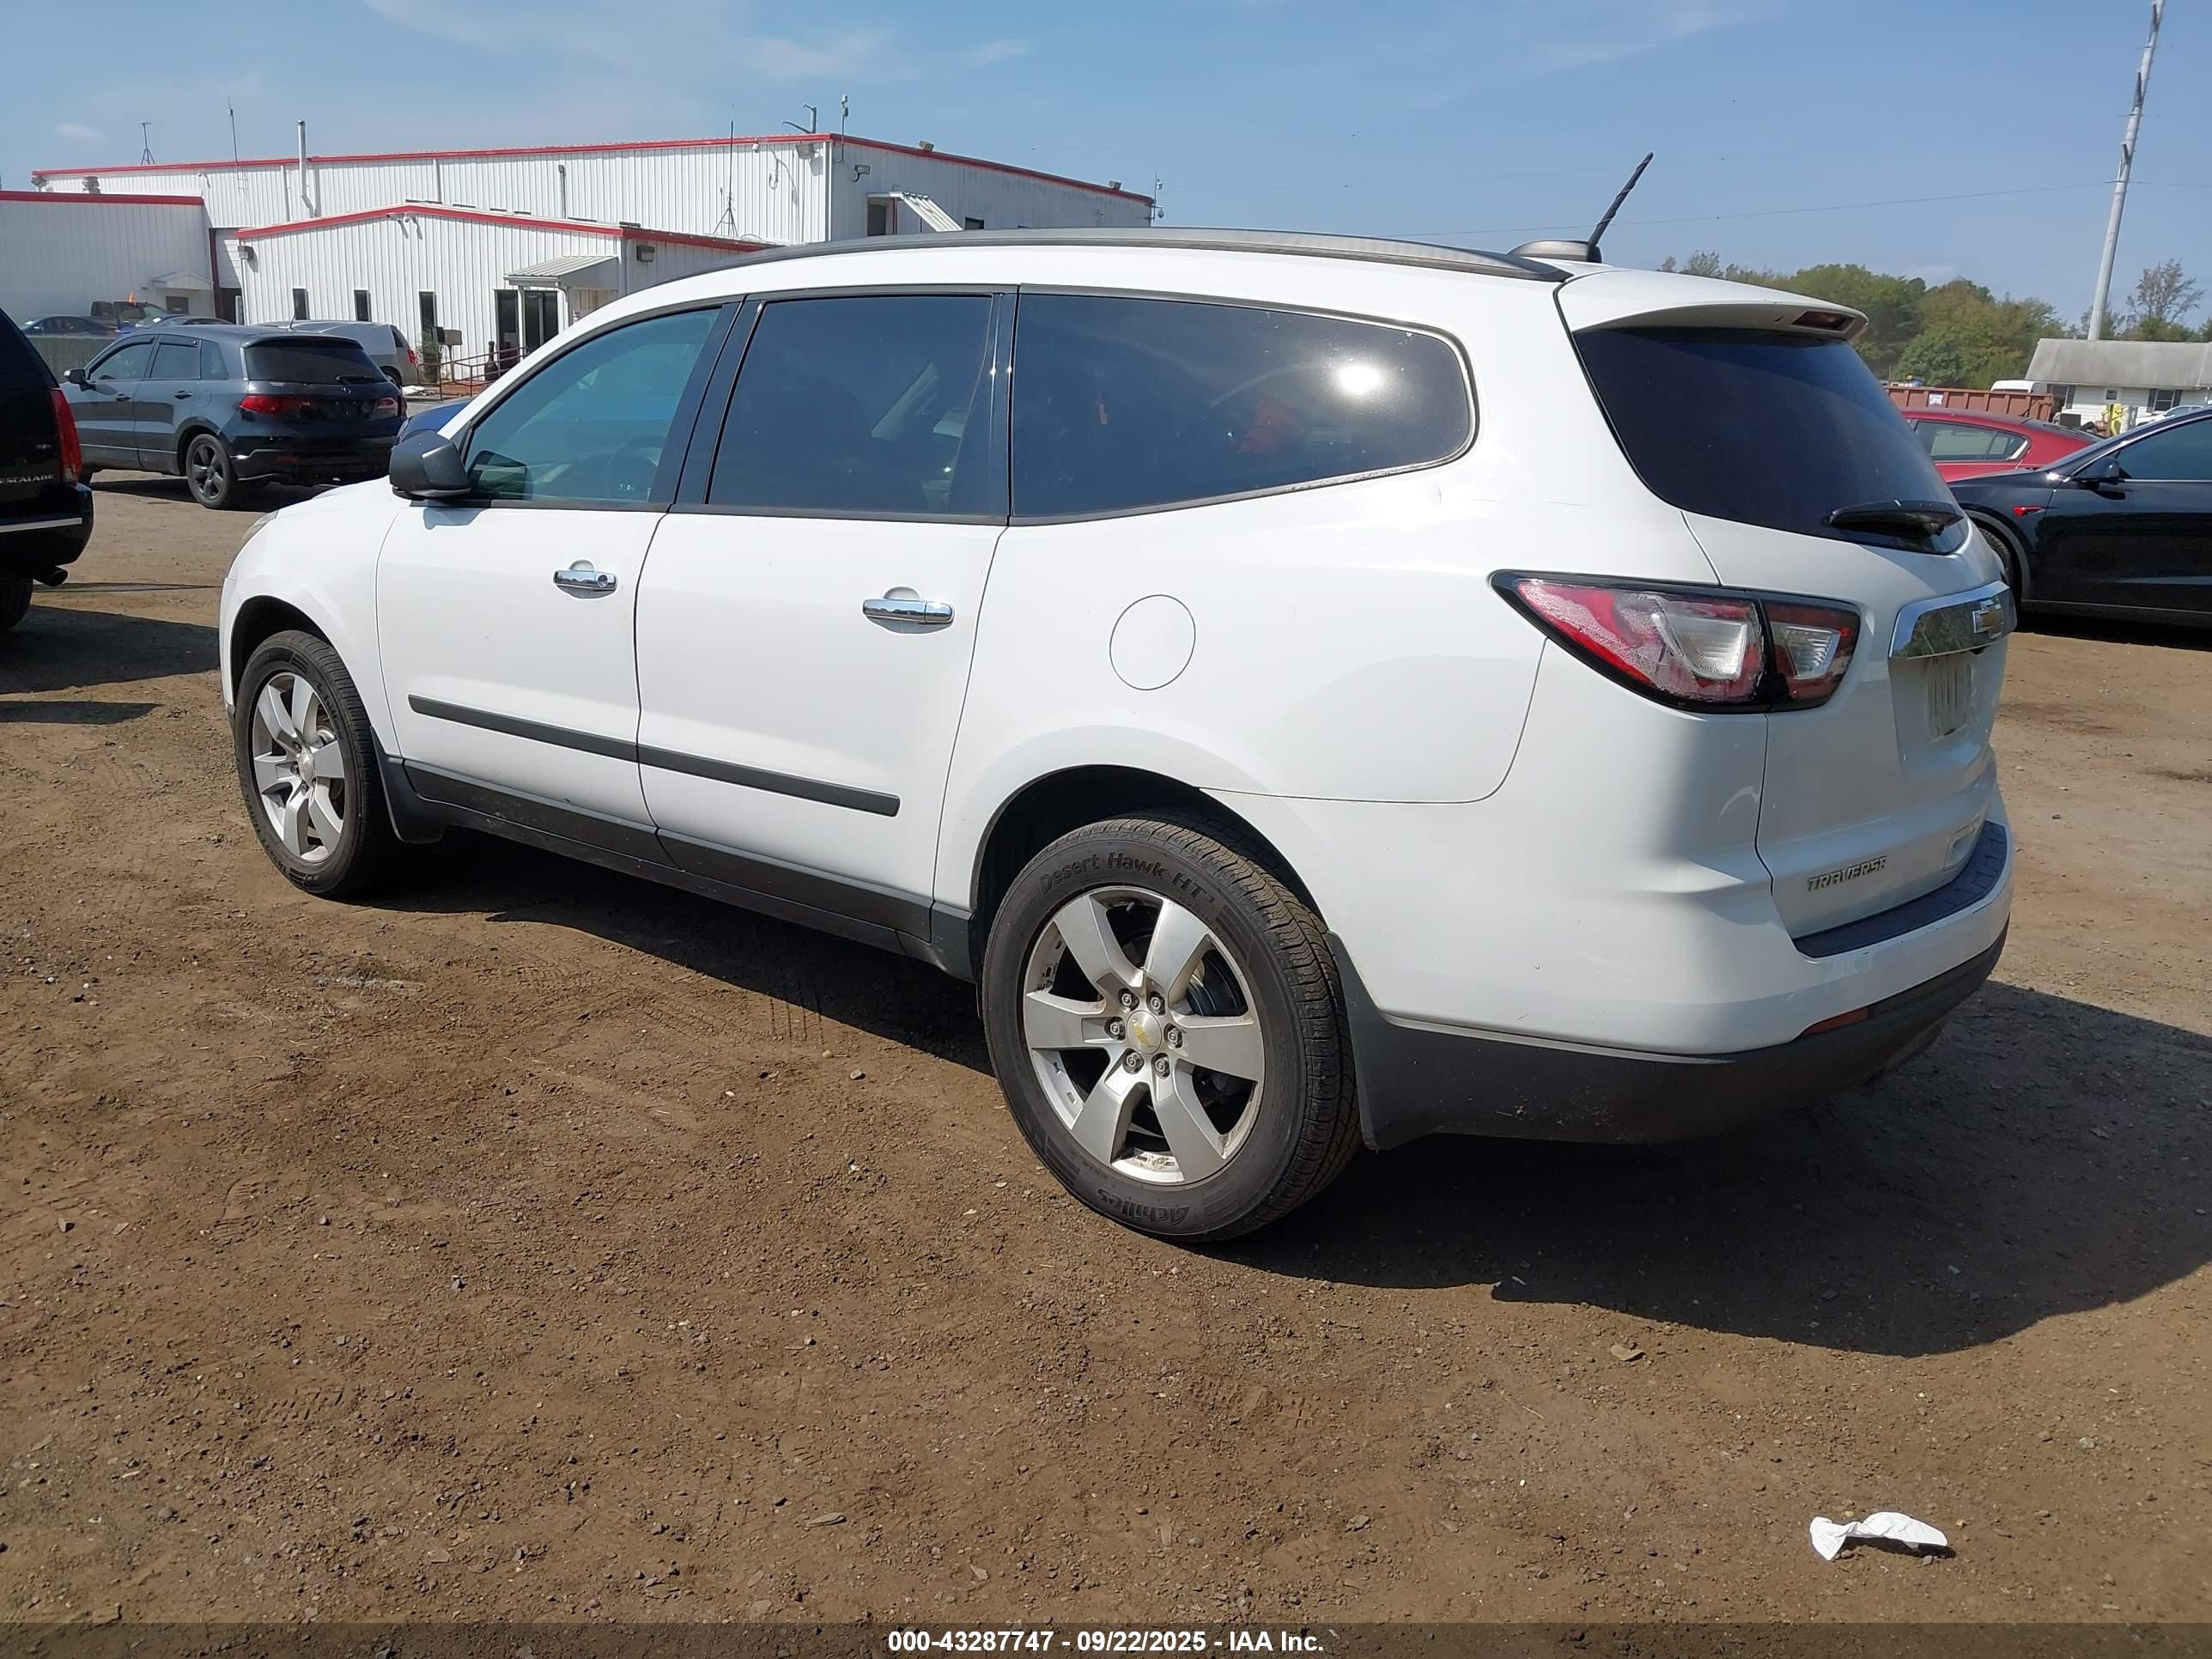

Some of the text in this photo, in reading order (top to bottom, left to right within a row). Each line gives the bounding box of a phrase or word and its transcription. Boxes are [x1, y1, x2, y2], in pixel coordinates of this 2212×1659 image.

[1039, 853, 1101, 895] Desert
[1107, 851, 1169, 879] Hawk
[1807, 855, 1887, 892] TRAVERSE
[1097, 1188, 1190, 1226] Achilles
